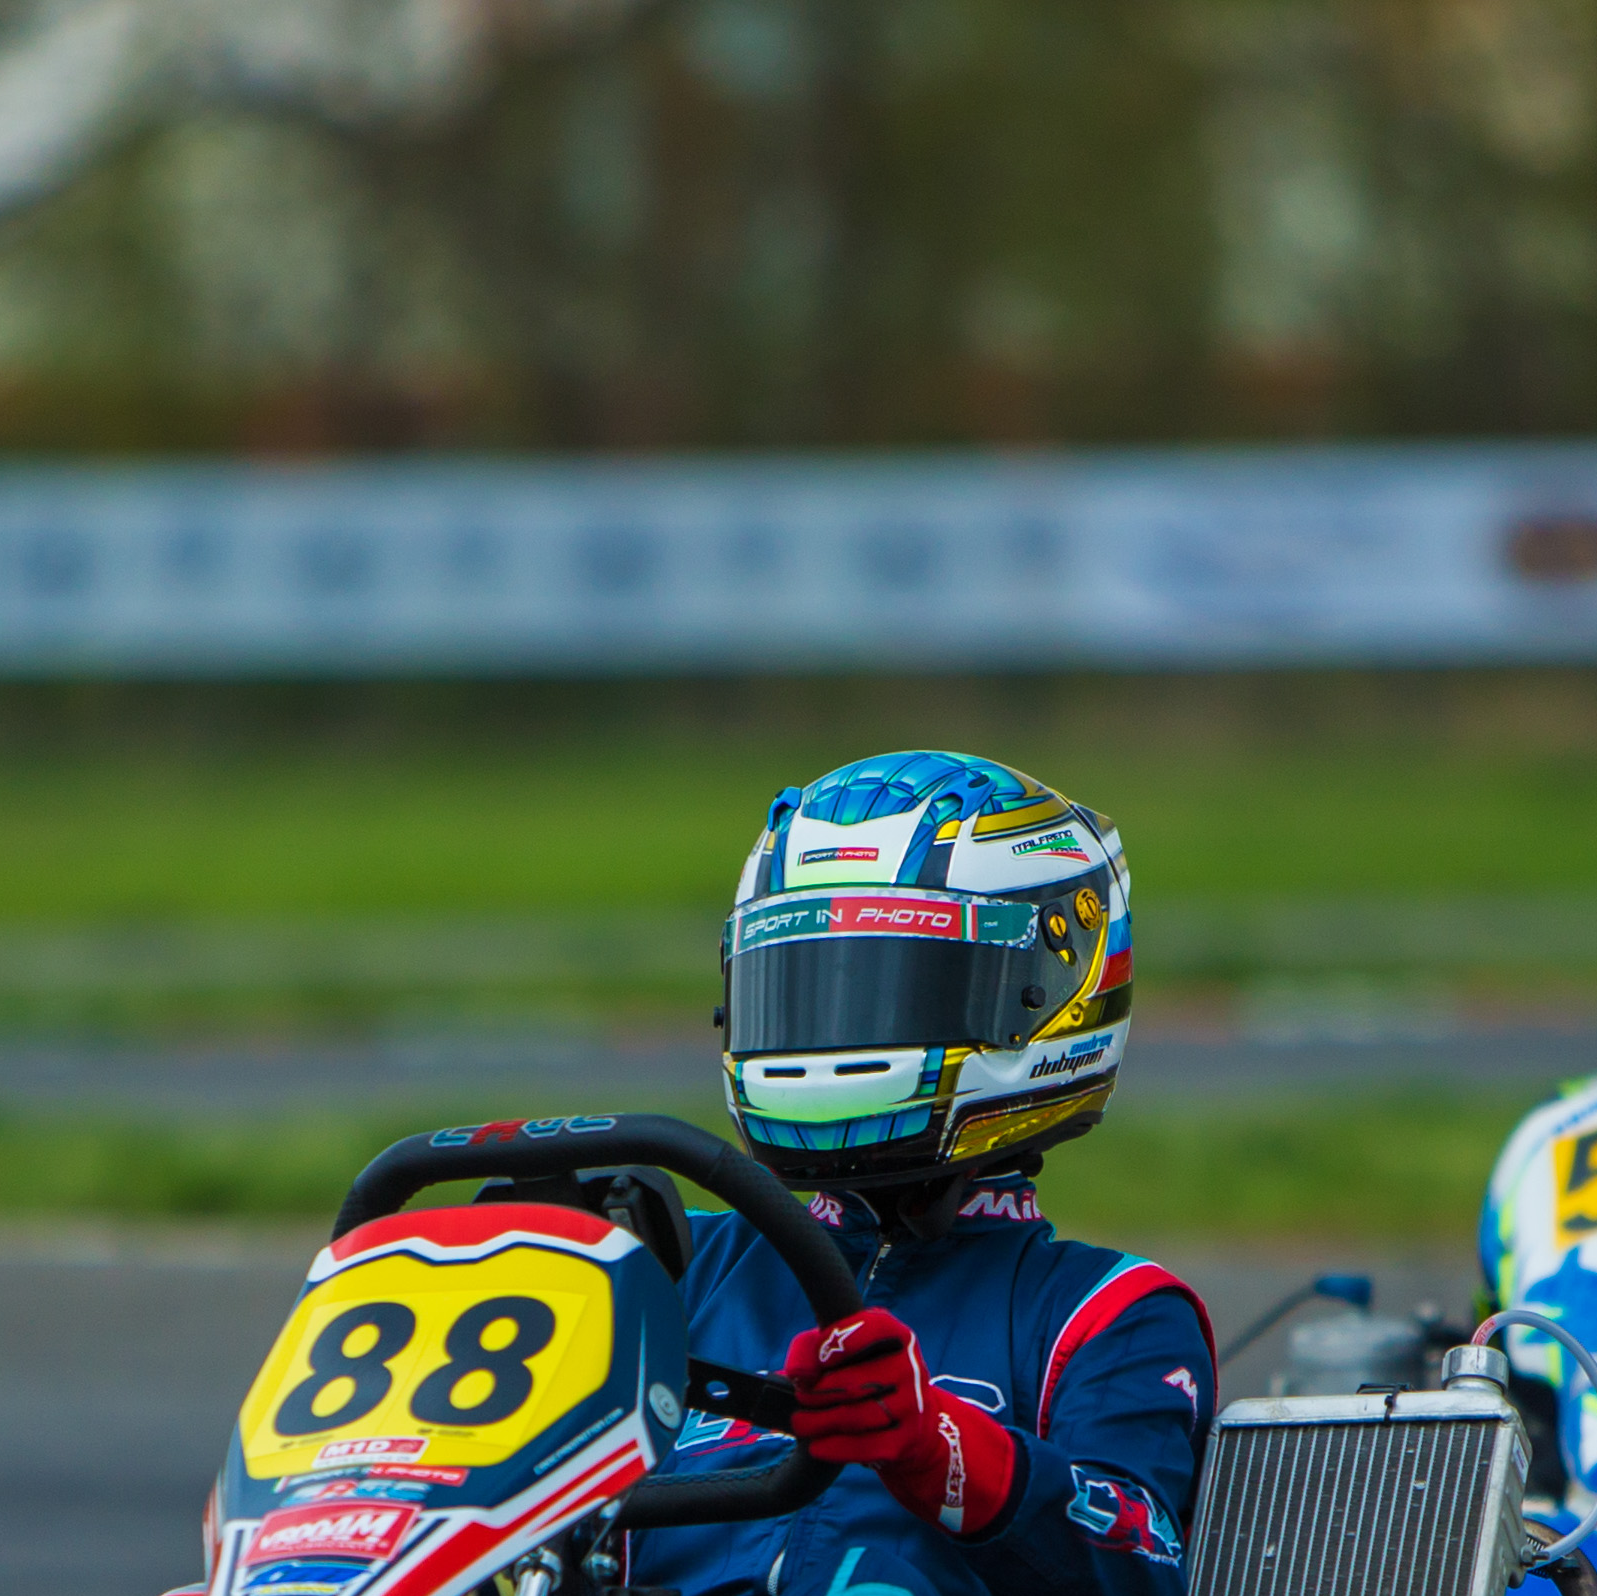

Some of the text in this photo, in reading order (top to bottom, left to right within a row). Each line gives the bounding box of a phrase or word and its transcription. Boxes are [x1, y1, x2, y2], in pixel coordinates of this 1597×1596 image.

[803, 851, 834, 863] SPORT
[844, 850, 877, 860] PHOTO
[743, 907, 954, 941] SPORT IN PHOTO
[271, 1295, 557, 1435] 88
[325, 1439, 391, 1457] M1D
